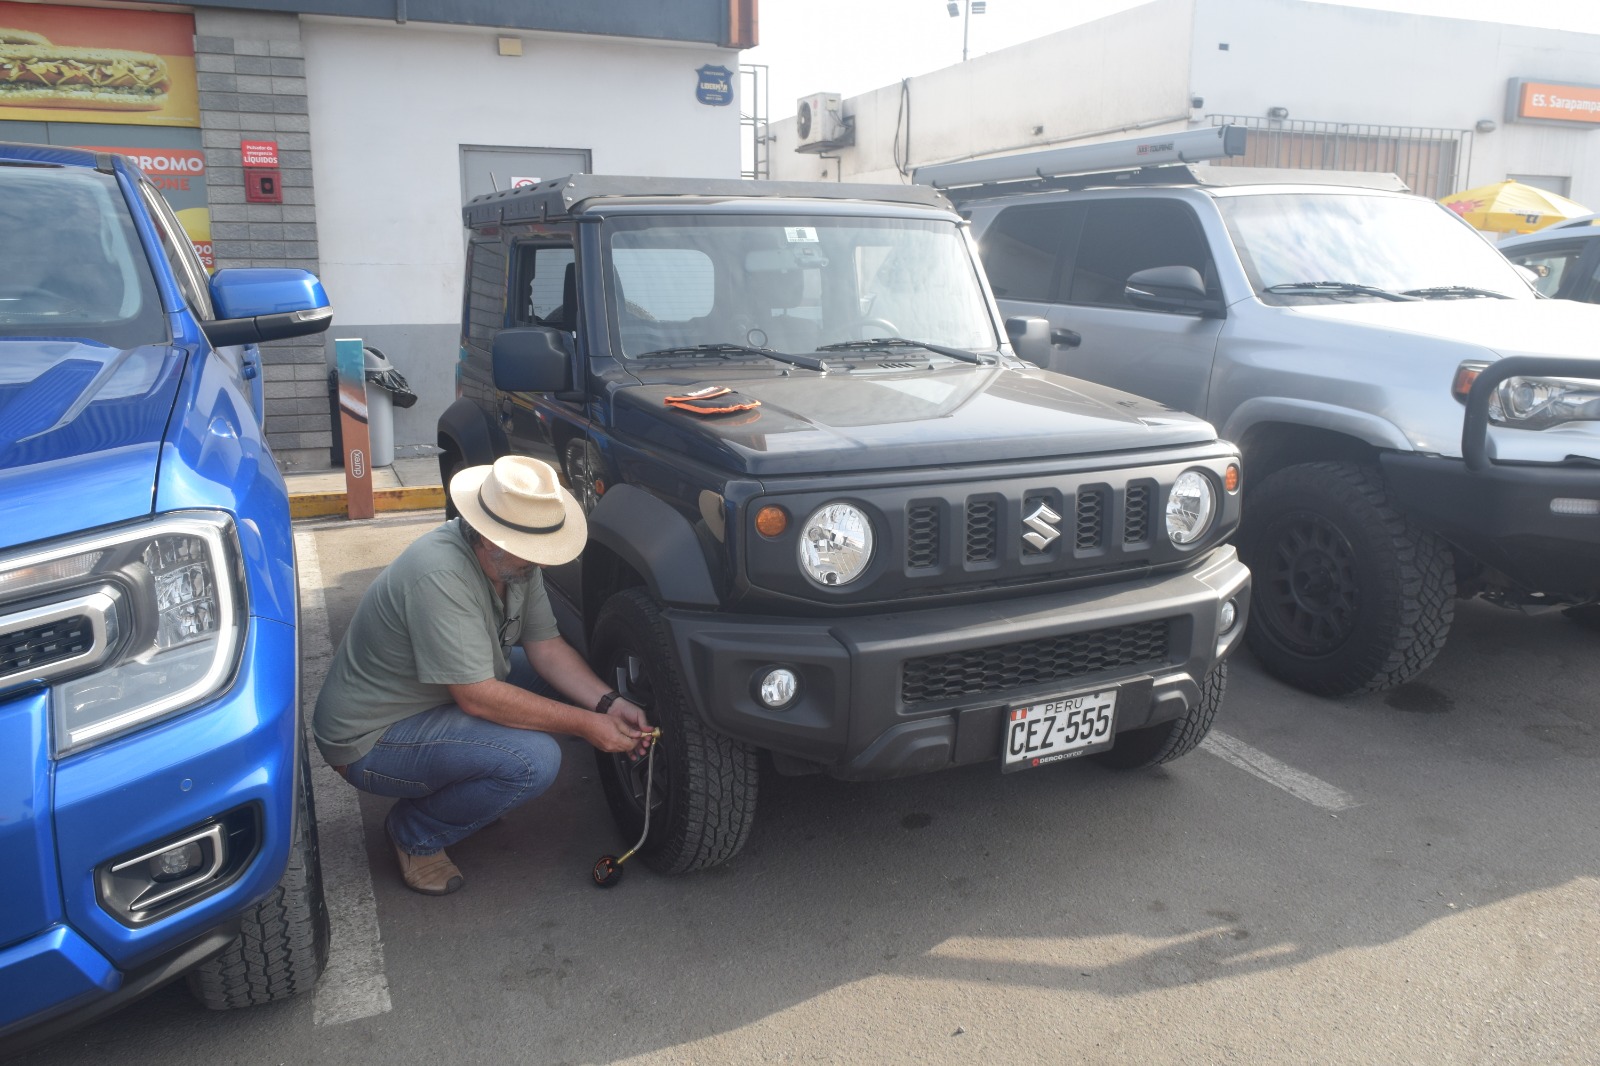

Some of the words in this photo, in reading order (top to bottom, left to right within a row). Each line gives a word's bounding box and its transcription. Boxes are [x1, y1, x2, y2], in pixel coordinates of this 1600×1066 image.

[1532, 93, 1547, 107] ES.
[353, 452, 362, 476] durex
[1044, 698, 1084, 714] PERU
[1009, 704, 1111, 756] CEZ-555
